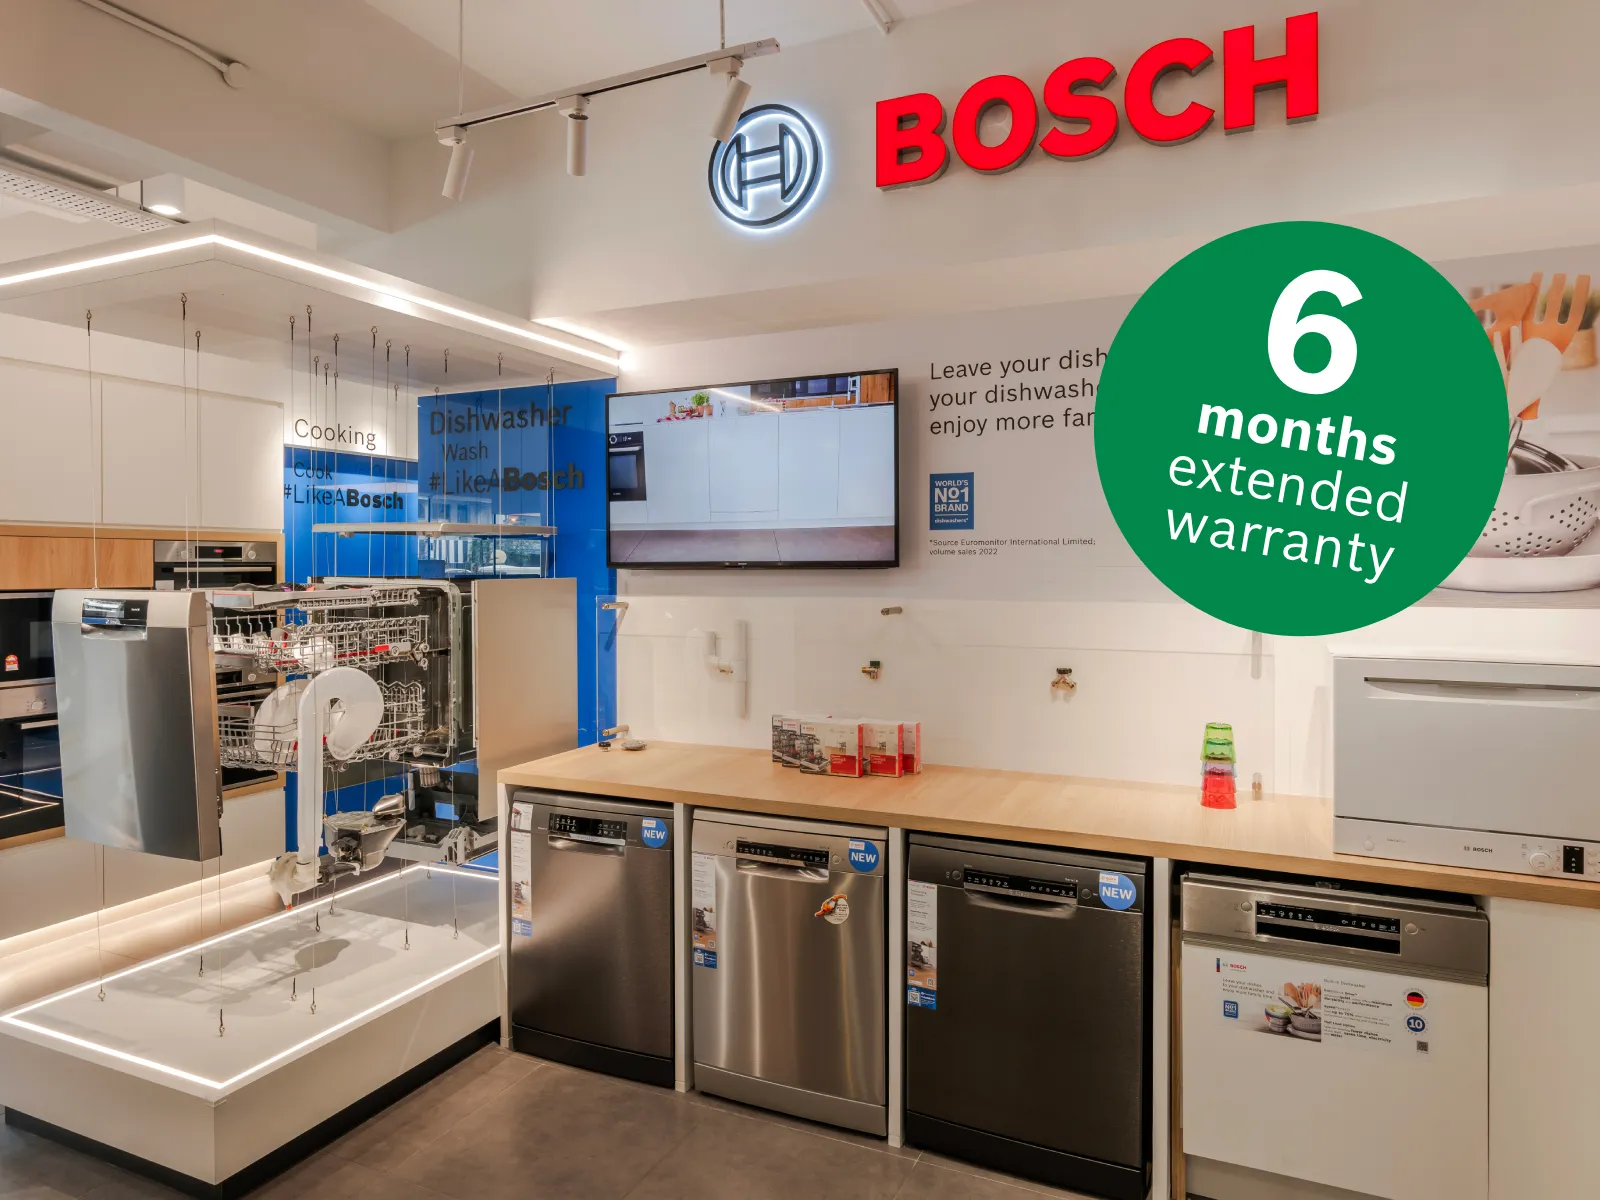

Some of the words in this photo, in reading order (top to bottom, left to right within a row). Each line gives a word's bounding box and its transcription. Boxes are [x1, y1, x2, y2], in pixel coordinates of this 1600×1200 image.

[876, 12, 1319, 188] BOSCH
[930, 362, 992, 380] Leave
[1000, 356, 1050, 378] your
[930, 391, 978, 411] your
[985, 378, 1100, 404] dishwash
[430, 402, 573, 436] Dishwasher
[930, 416, 988, 438] enjoy
[996, 414, 1054, 431] more
[294, 418, 376, 451] Cooking
[442, 442, 488, 462] Wash
[294, 462, 334, 480] Cook
[429, 462, 584, 494] #LikeABosch
[283, 483, 404, 510] #LikeABosch
[934, 504, 969, 512] BRAND
[644, 830, 666, 840] NEW
[851, 852, 876, 864] NEW
[1102, 886, 1132, 900] NEW
[1409, 1019, 1422, 1028] 10
